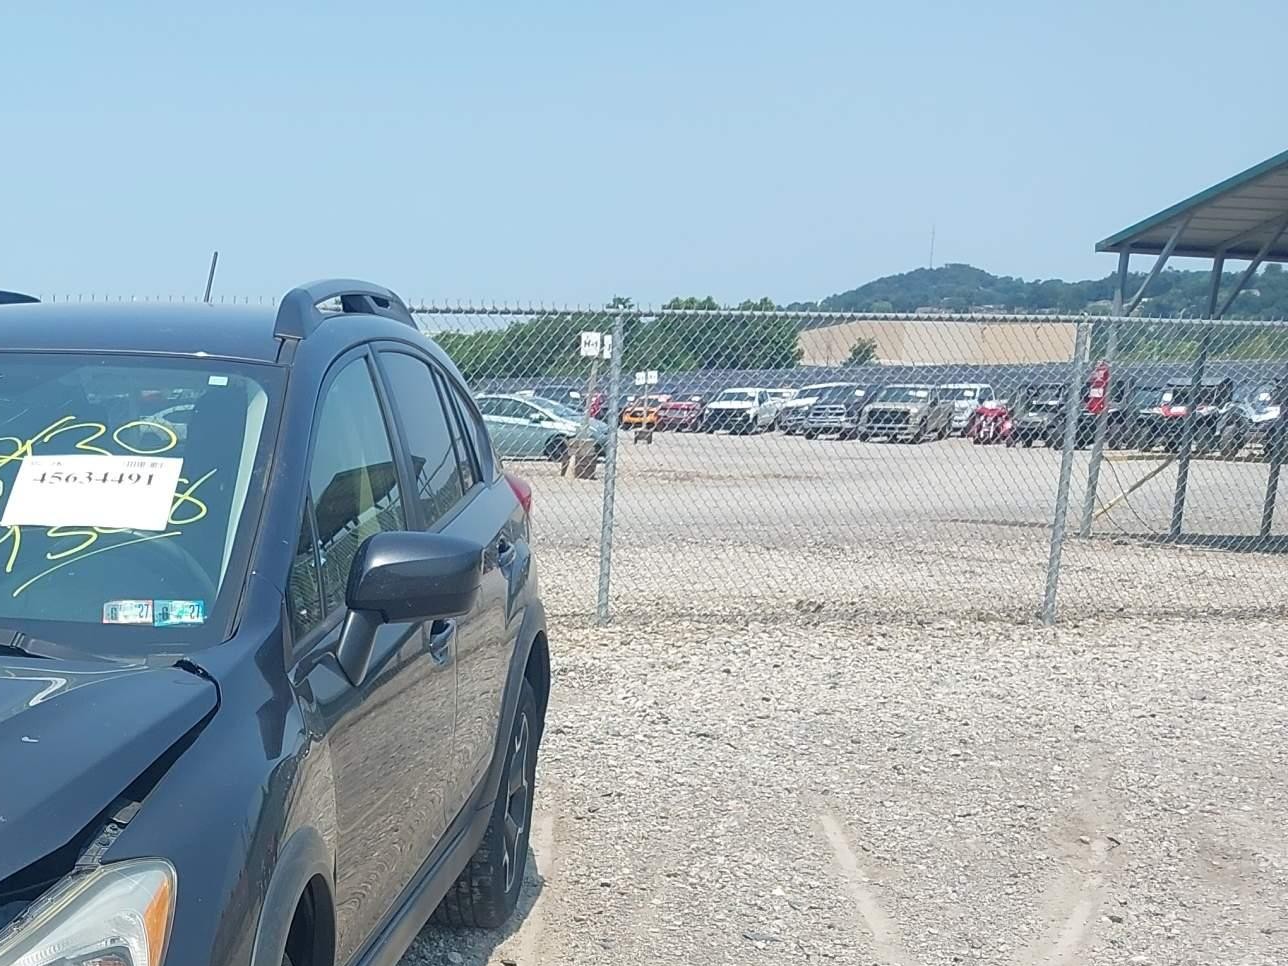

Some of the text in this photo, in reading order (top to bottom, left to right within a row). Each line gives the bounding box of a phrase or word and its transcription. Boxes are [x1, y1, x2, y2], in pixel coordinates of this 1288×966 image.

[32, 471, 154, 486] 45634491
[138, 603, 150, 619] 27
[189, 604, 201, 620] 27
